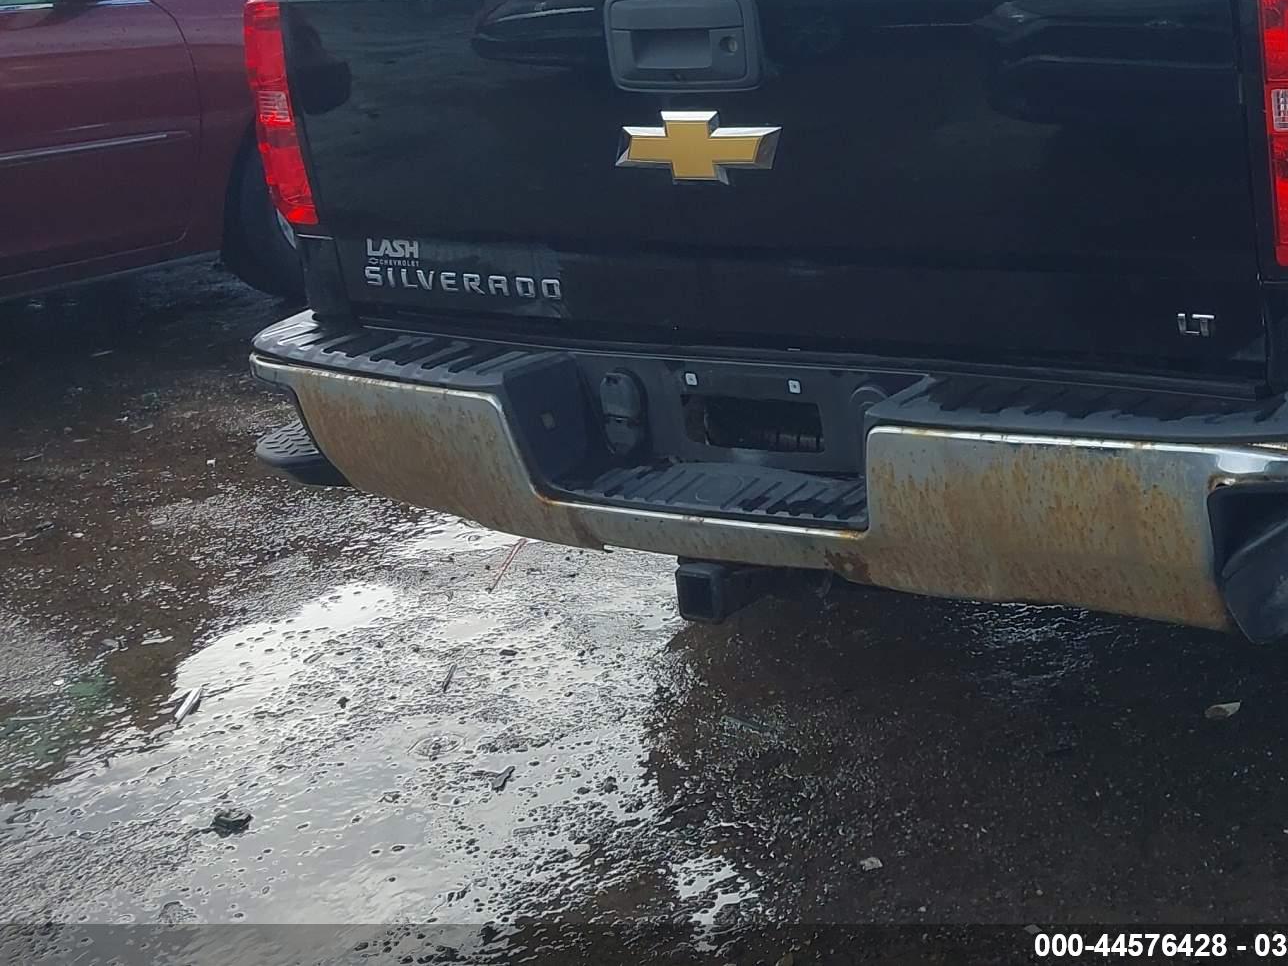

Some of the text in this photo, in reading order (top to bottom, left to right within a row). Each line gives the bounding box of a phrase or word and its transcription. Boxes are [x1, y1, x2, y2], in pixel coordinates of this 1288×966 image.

[366, 238, 419, 258] LASH
[379, 259, 419, 267] CHEVROLET
[365, 266, 562, 299] SILVERADO
[1177, 313, 1216, 337] LT
